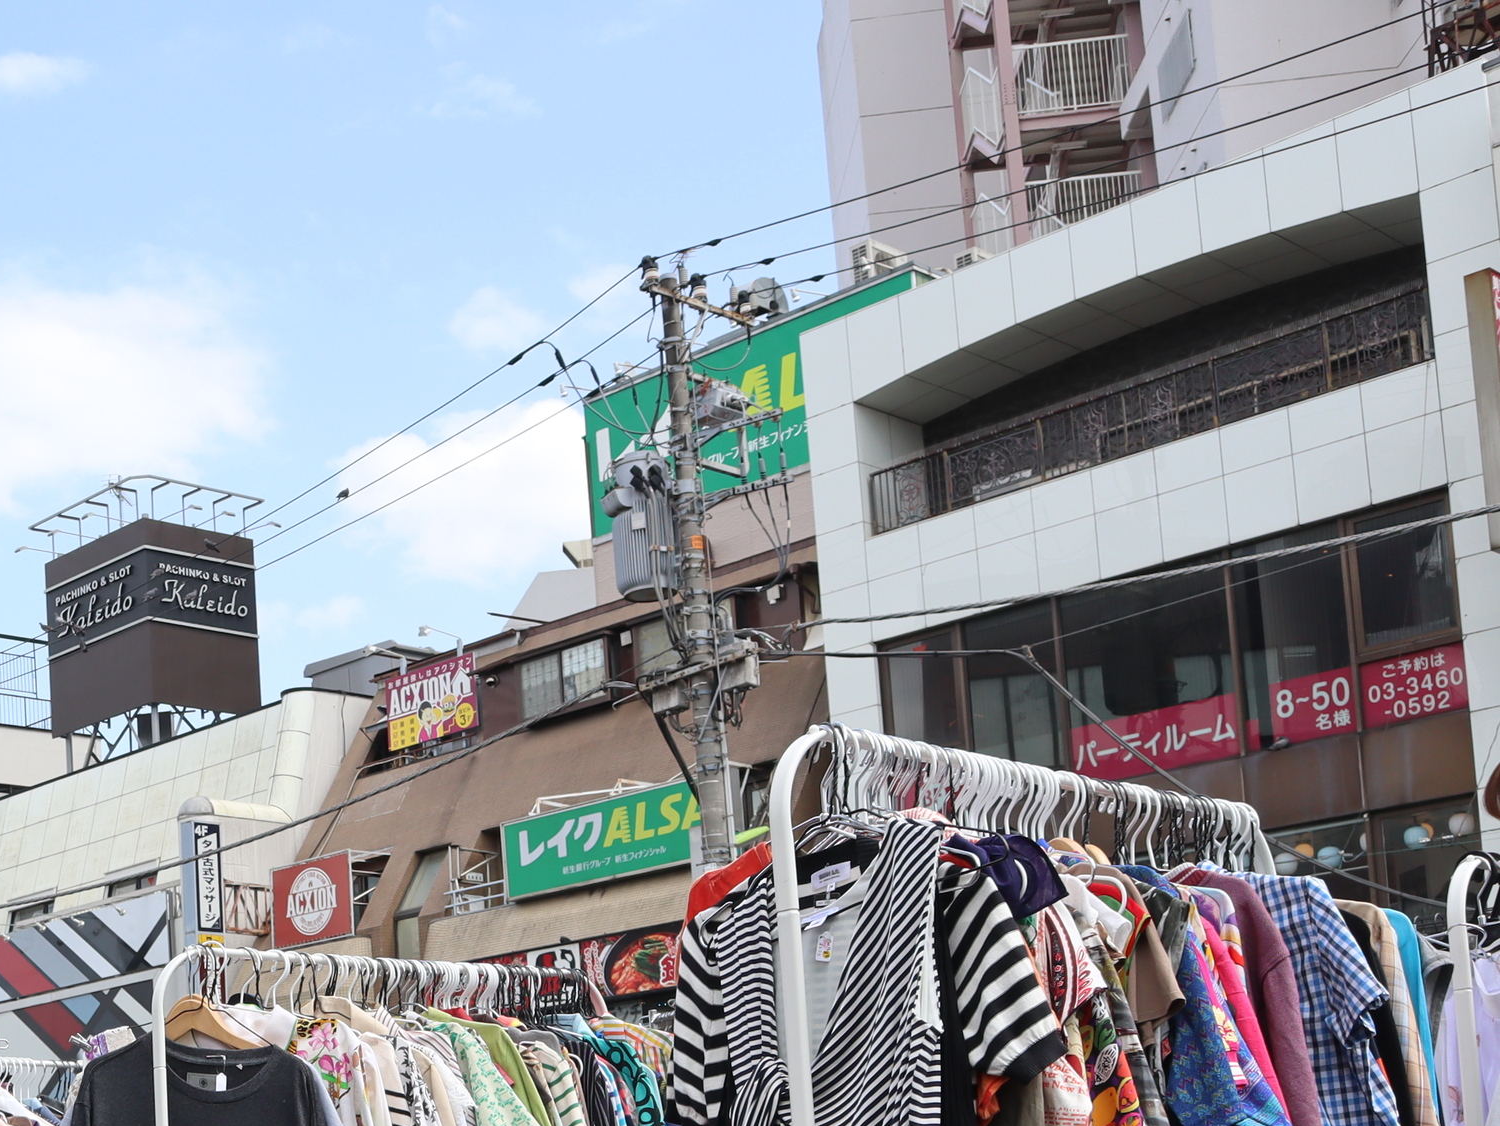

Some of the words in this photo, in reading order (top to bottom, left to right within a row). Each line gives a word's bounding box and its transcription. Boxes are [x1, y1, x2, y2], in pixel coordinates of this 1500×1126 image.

[55, 581, 98, 607] PACHINKO
[100, 576, 107, 587] &
[108, 564, 132, 582] SLOT
[159, 562, 210, 580] PACHINKO
[212, 572, 220, 582] &
[222, 574, 247, 587] SLOT
[57, 582, 133, 638] Kaleido
[161, 579, 249, 618] Kaleido
[1382, 652, 1445, 679] ご予約は
[389, 671, 452, 717] ACXION
[1368, 667, 1463, 703] 03-3460
[460, 714, 471, 726] 3F
[1315, 708, 1351, 730] 名様
[1384, 691, 1451, 718] -0592
[1077, 714, 1235, 770] パーティルーム
[194, 824, 209, 837] 4F
[519, 793, 701, 867] レイクALSA
[286, 884, 338, 918] ACXION
